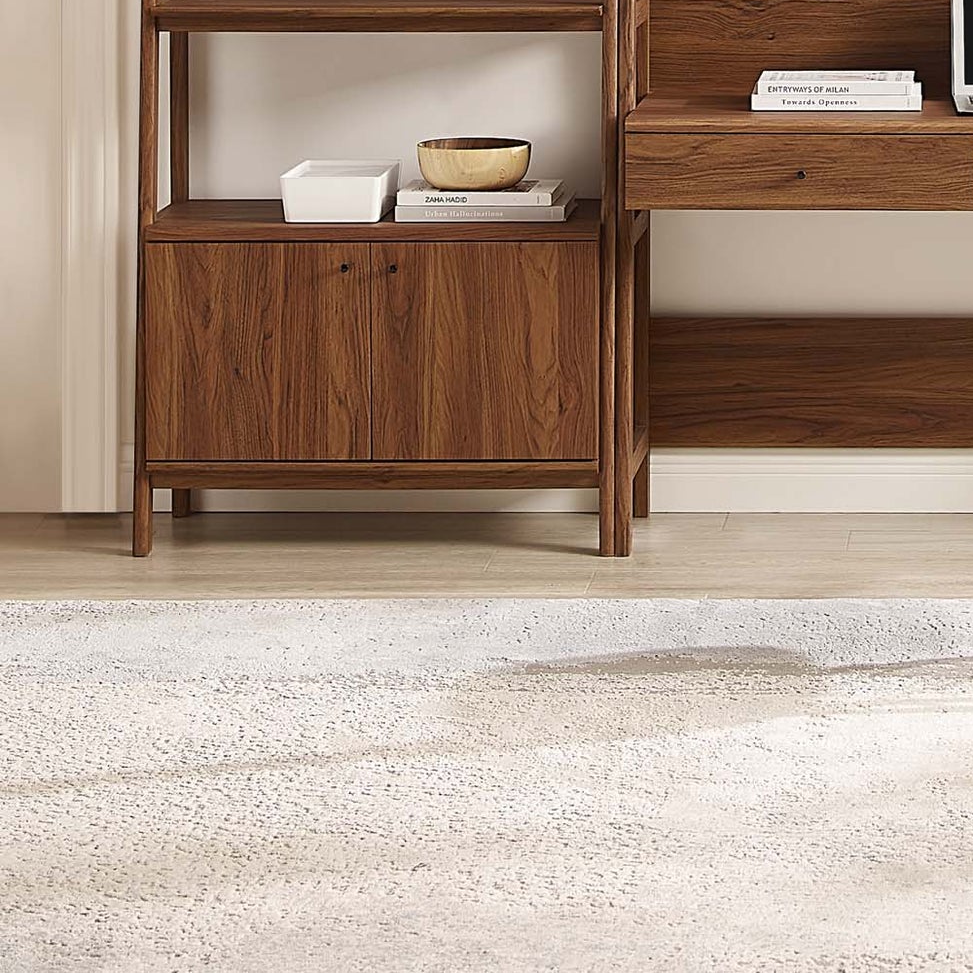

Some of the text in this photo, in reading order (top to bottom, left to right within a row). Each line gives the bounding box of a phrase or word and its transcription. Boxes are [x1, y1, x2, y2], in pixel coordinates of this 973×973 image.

[767, 85, 850, 93] ENTRYWAYS OF MILAN
[781, 98, 858, 107] Towards Openness
[424, 196, 468, 204] ZAHA HADID
